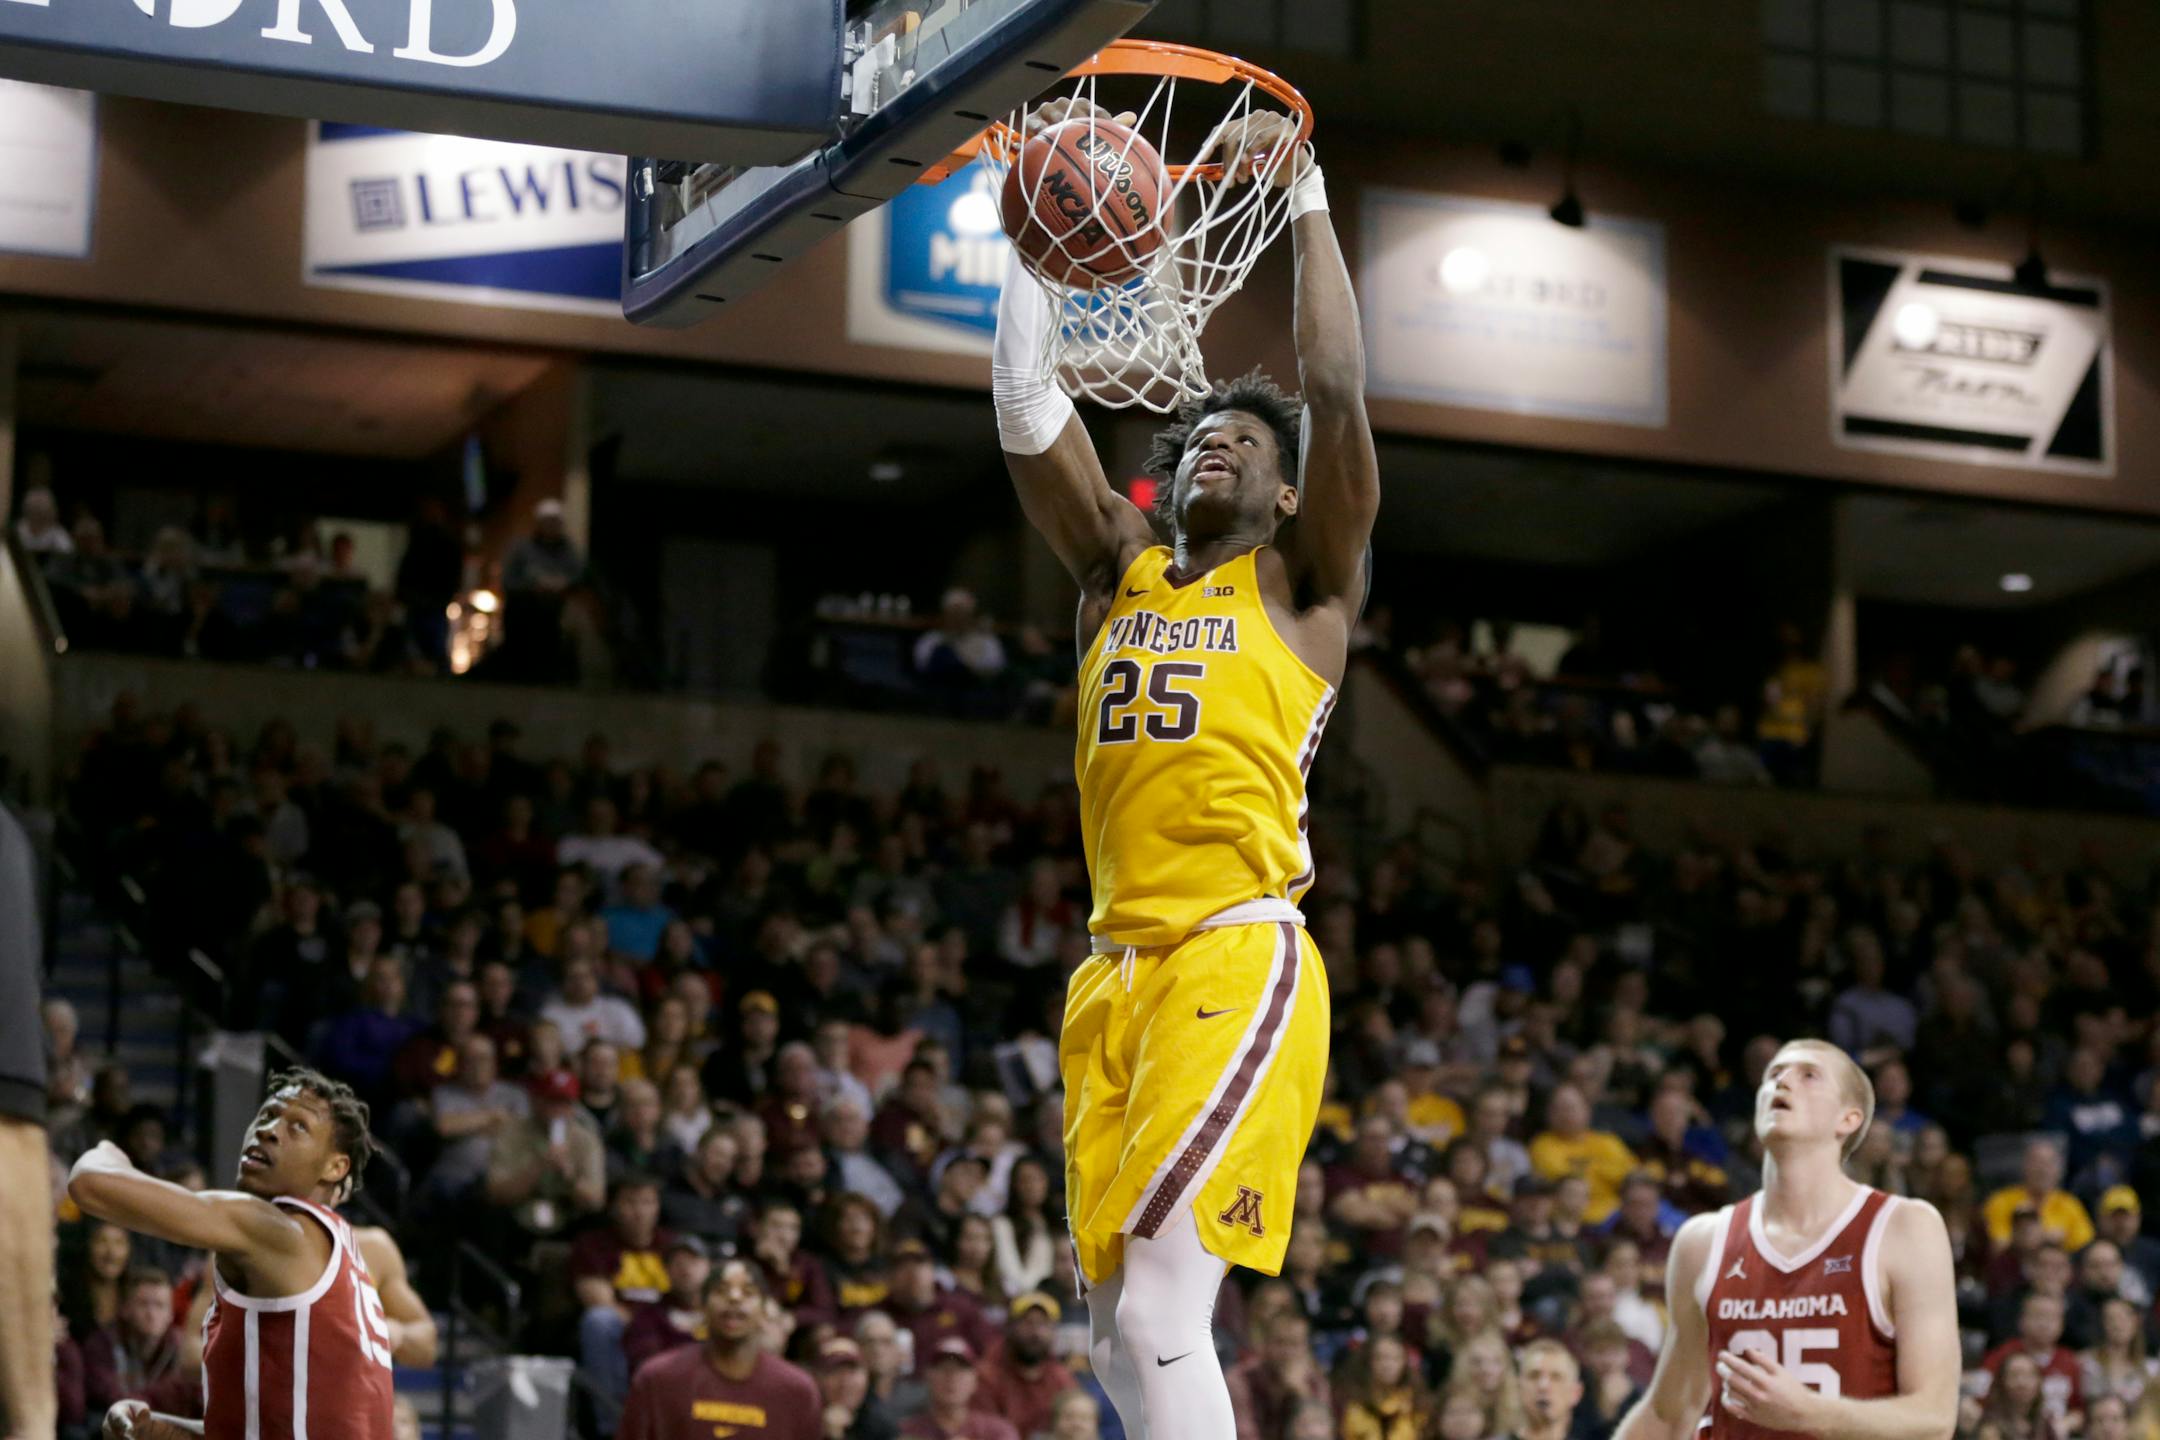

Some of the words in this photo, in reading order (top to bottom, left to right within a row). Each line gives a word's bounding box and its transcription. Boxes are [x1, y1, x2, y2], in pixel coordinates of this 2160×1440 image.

[416, 156, 624, 226] LEWIS
[1076, 130, 1151, 231] Wilson
[1097, 658, 1205, 745] 25
[1217, 1185, 1265, 1238] M
[349, 1268, 392, 1371] 15
[1718, 1294, 1848, 1320] OKLAHOMA
